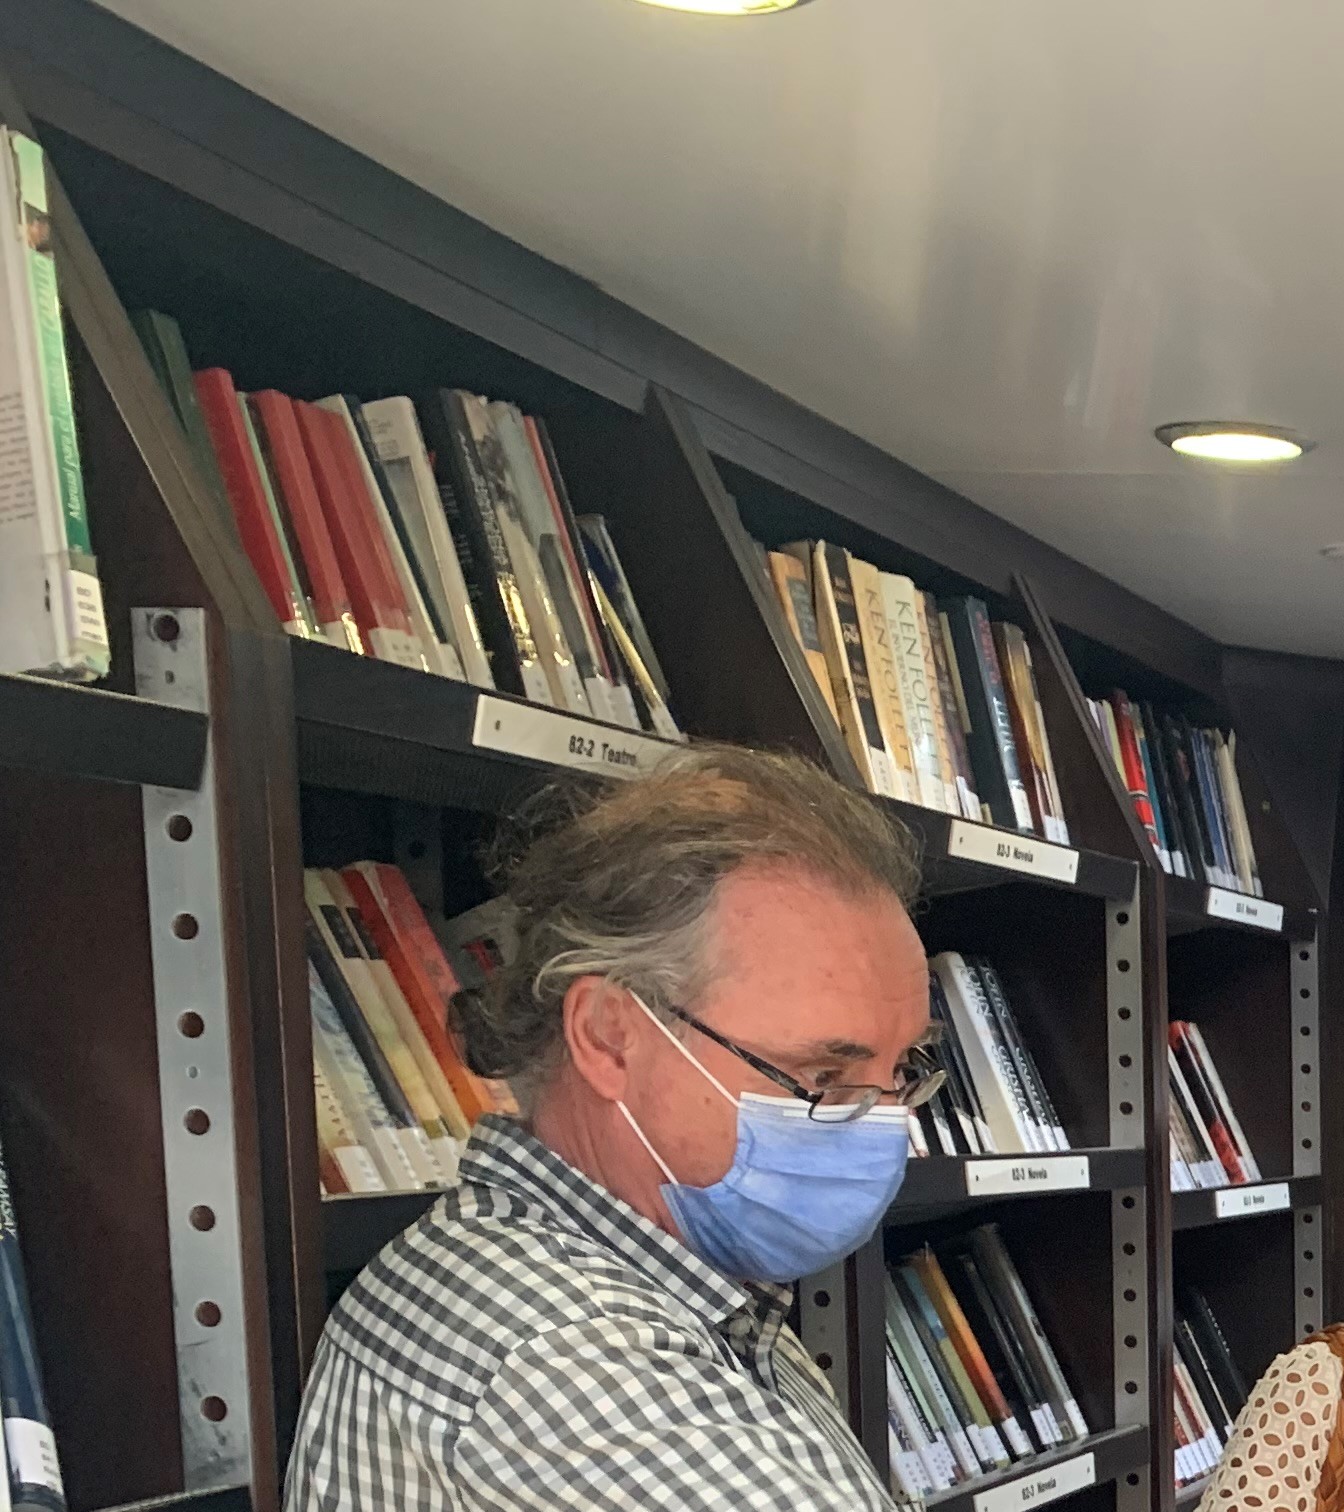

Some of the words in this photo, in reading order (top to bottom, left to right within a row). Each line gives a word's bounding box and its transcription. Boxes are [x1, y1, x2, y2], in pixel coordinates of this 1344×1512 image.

[862, 585, 890, 649] KEN
[892, 596, 924, 660] KEN
[569, 735, 595, 758] 82-2
[905, 664, 951, 781] FOLLETT
